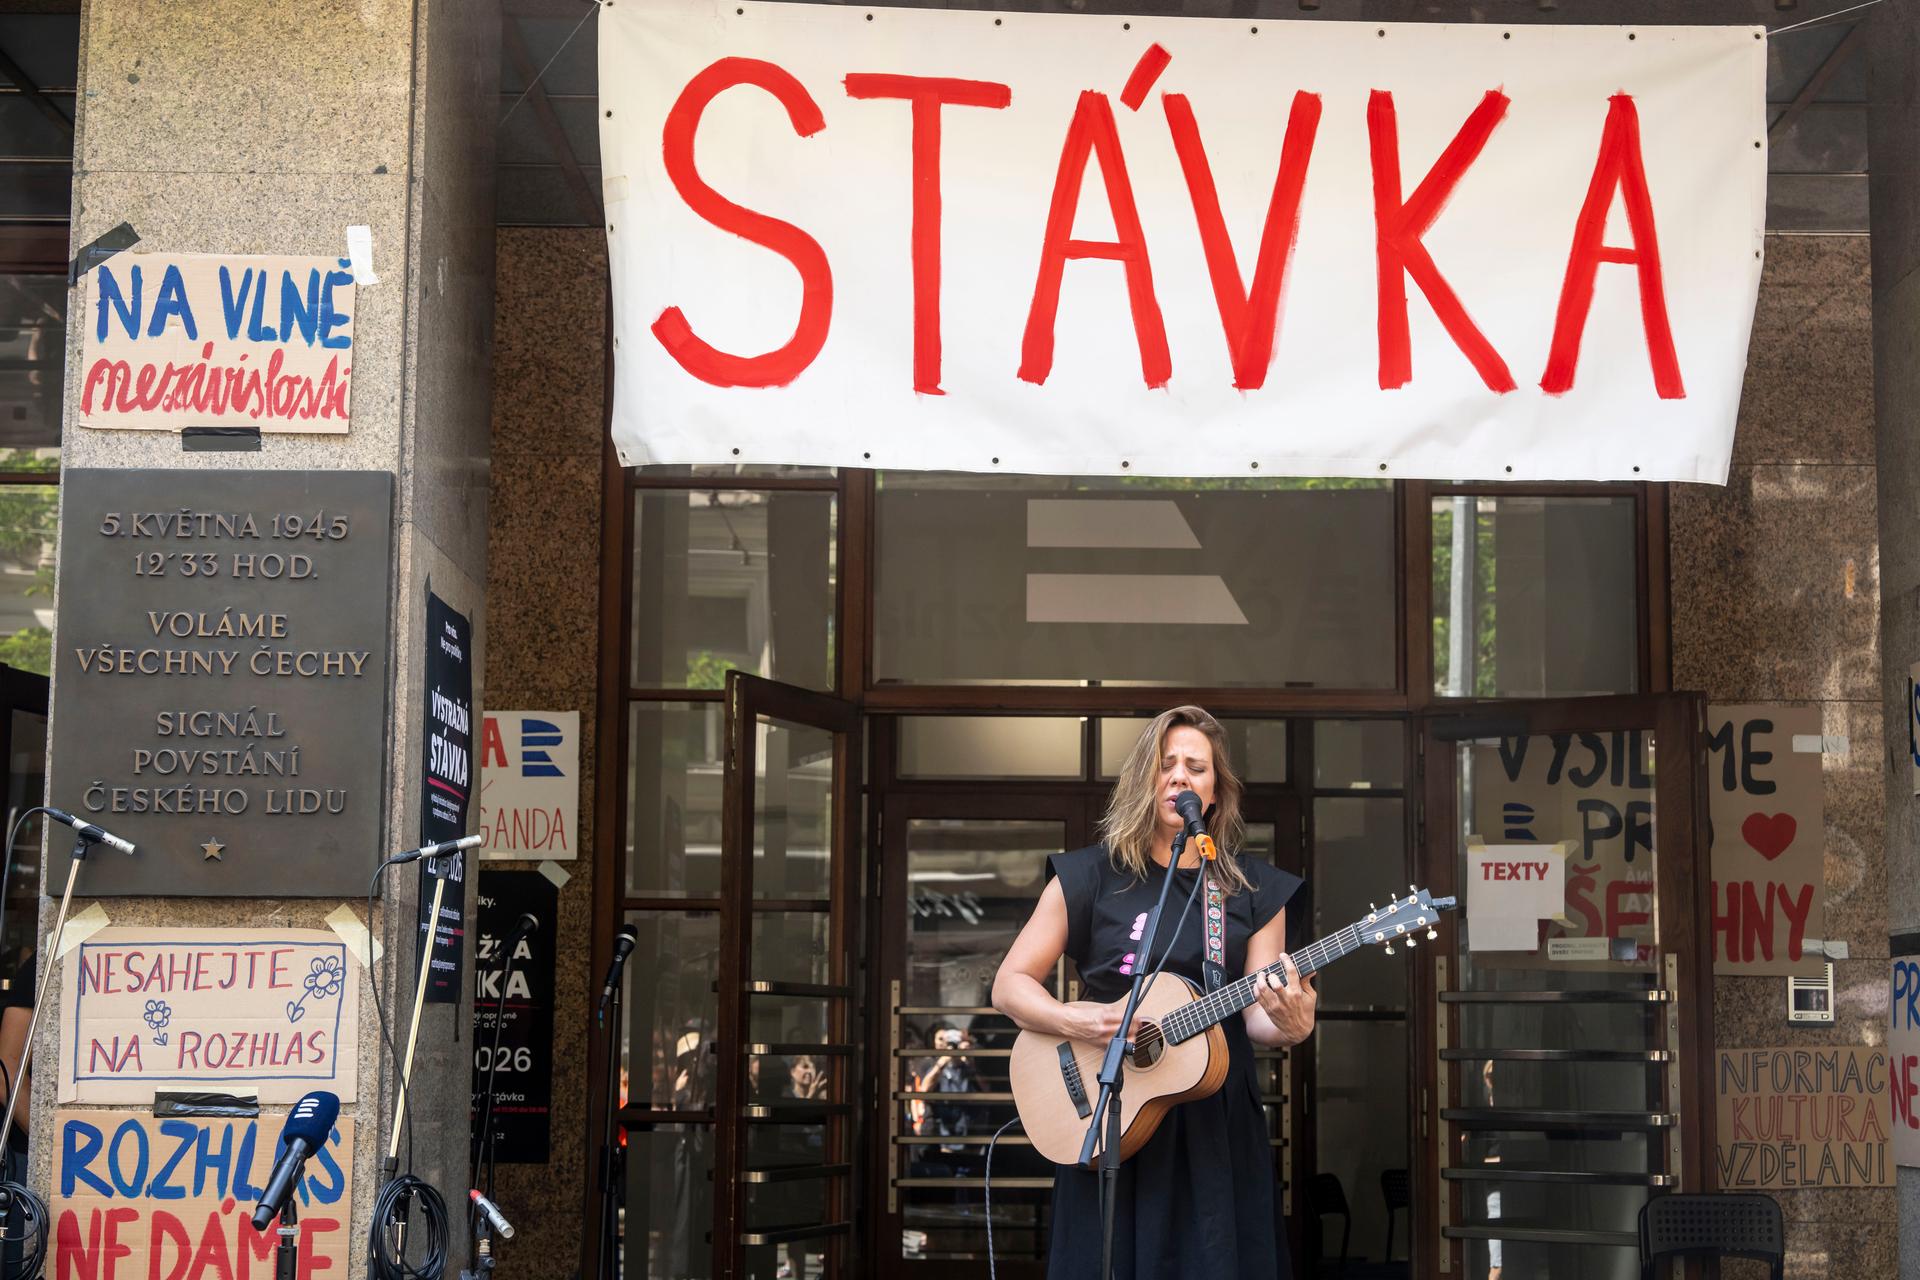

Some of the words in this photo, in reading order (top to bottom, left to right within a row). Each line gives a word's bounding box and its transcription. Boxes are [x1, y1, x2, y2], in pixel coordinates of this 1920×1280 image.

[651, 42, 1686, 400] STÁVKA
[96, 264, 198, 343] NA
[131, 508, 261, 539] KVĚTNA
[272, 509, 349, 541] 1945
[232, 552, 319, 580] HOD.
[148, 606, 288, 639] VOLÁME
[75, 643, 240, 676] VŠECHNY
[250, 644, 372, 677] ČECHY
[156, 705, 287, 738] SIGNÁL
[133, 743, 301, 777] POVSTÁNÍ
[430, 727, 468, 787] STÁVKA
[83, 781, 249, 815] ČESKÉHO
[265, 789, 347, 815] LIDU
[1480, 861, 1550, 881] TEXTY
[89, 1034, 143, 1073] NA
[178, 1030, 326, 1070] ROZHLAS
[1720, 1050, 1885, 1095] NFORMAC
[1732, 1095, 1885, 1143] KULTURA
